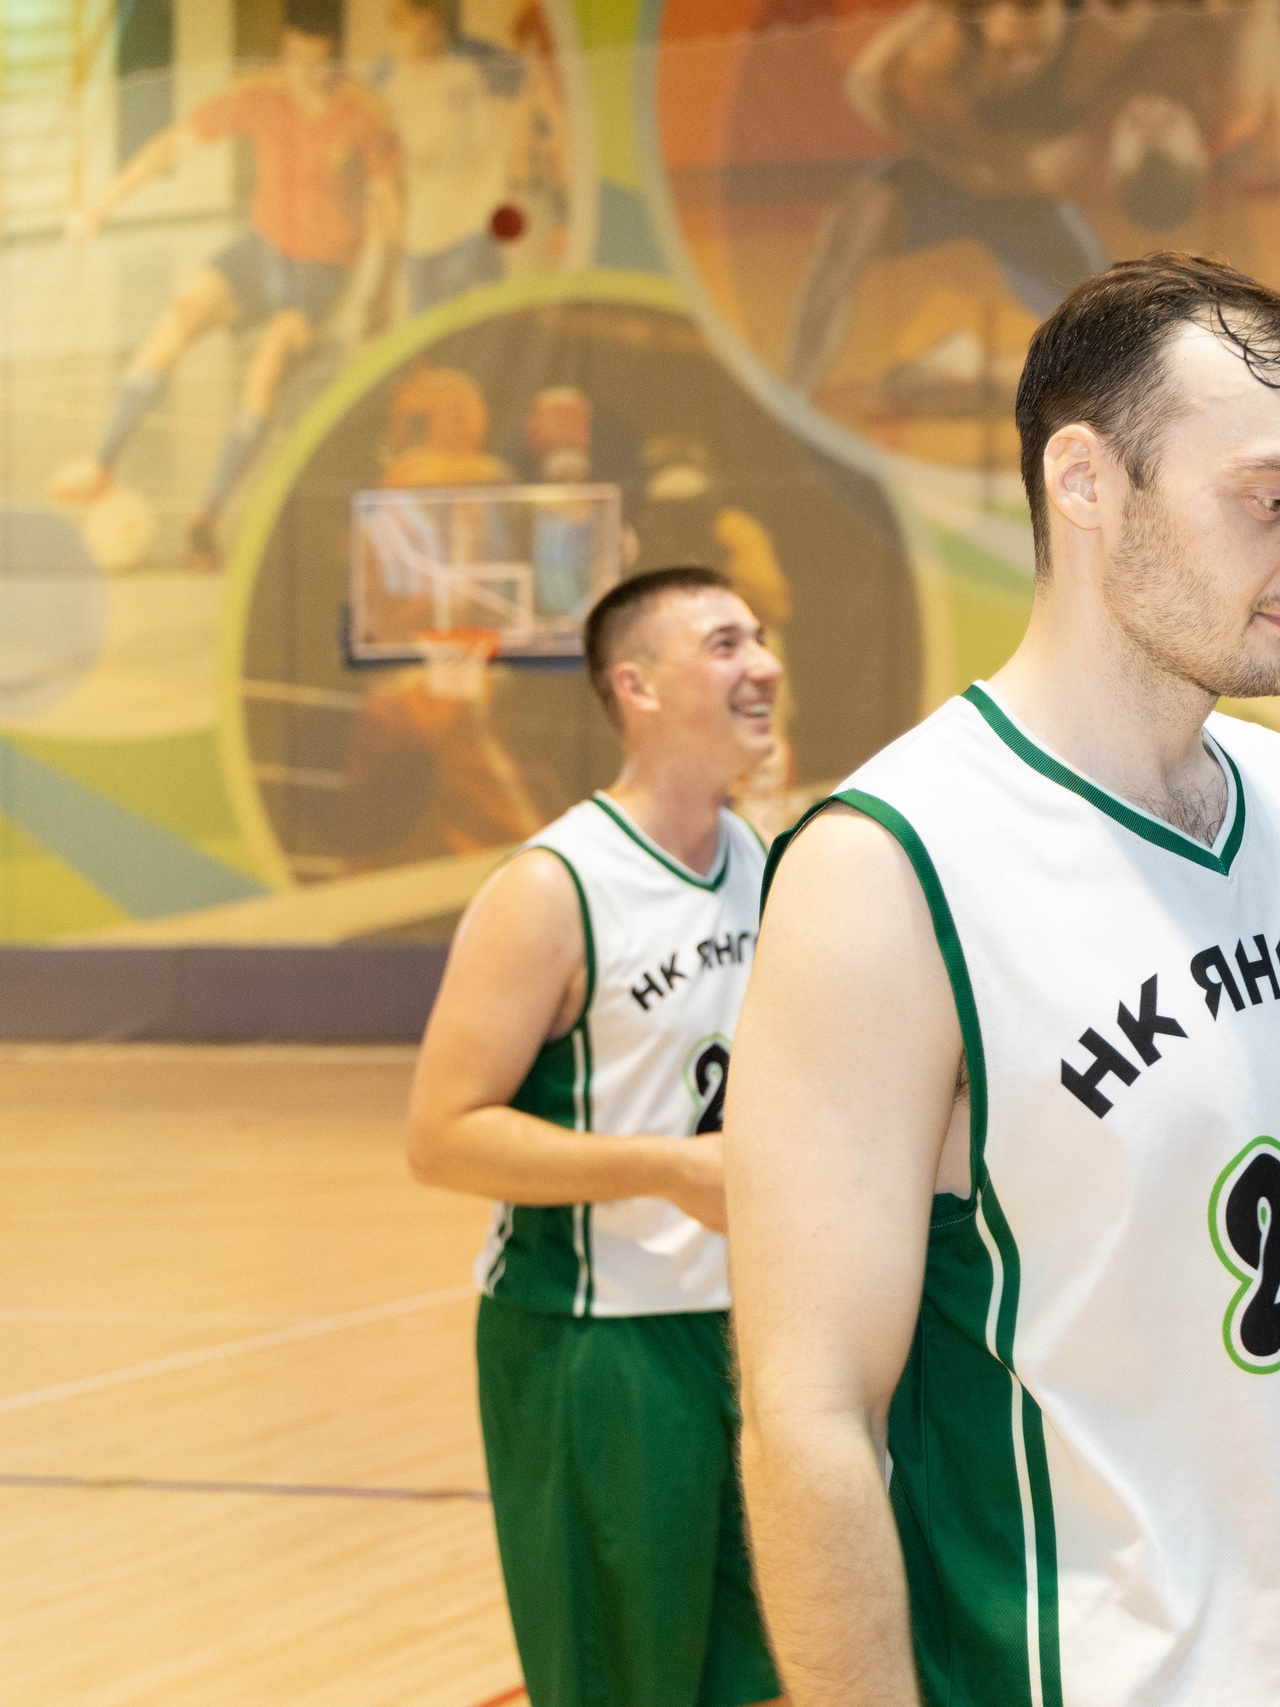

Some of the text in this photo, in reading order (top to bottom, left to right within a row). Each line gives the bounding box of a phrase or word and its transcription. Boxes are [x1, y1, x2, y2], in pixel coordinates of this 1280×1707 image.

[631, 930, 757, 1012] НК ЯНГ
[1060, 972, 1190, 1120] НК
